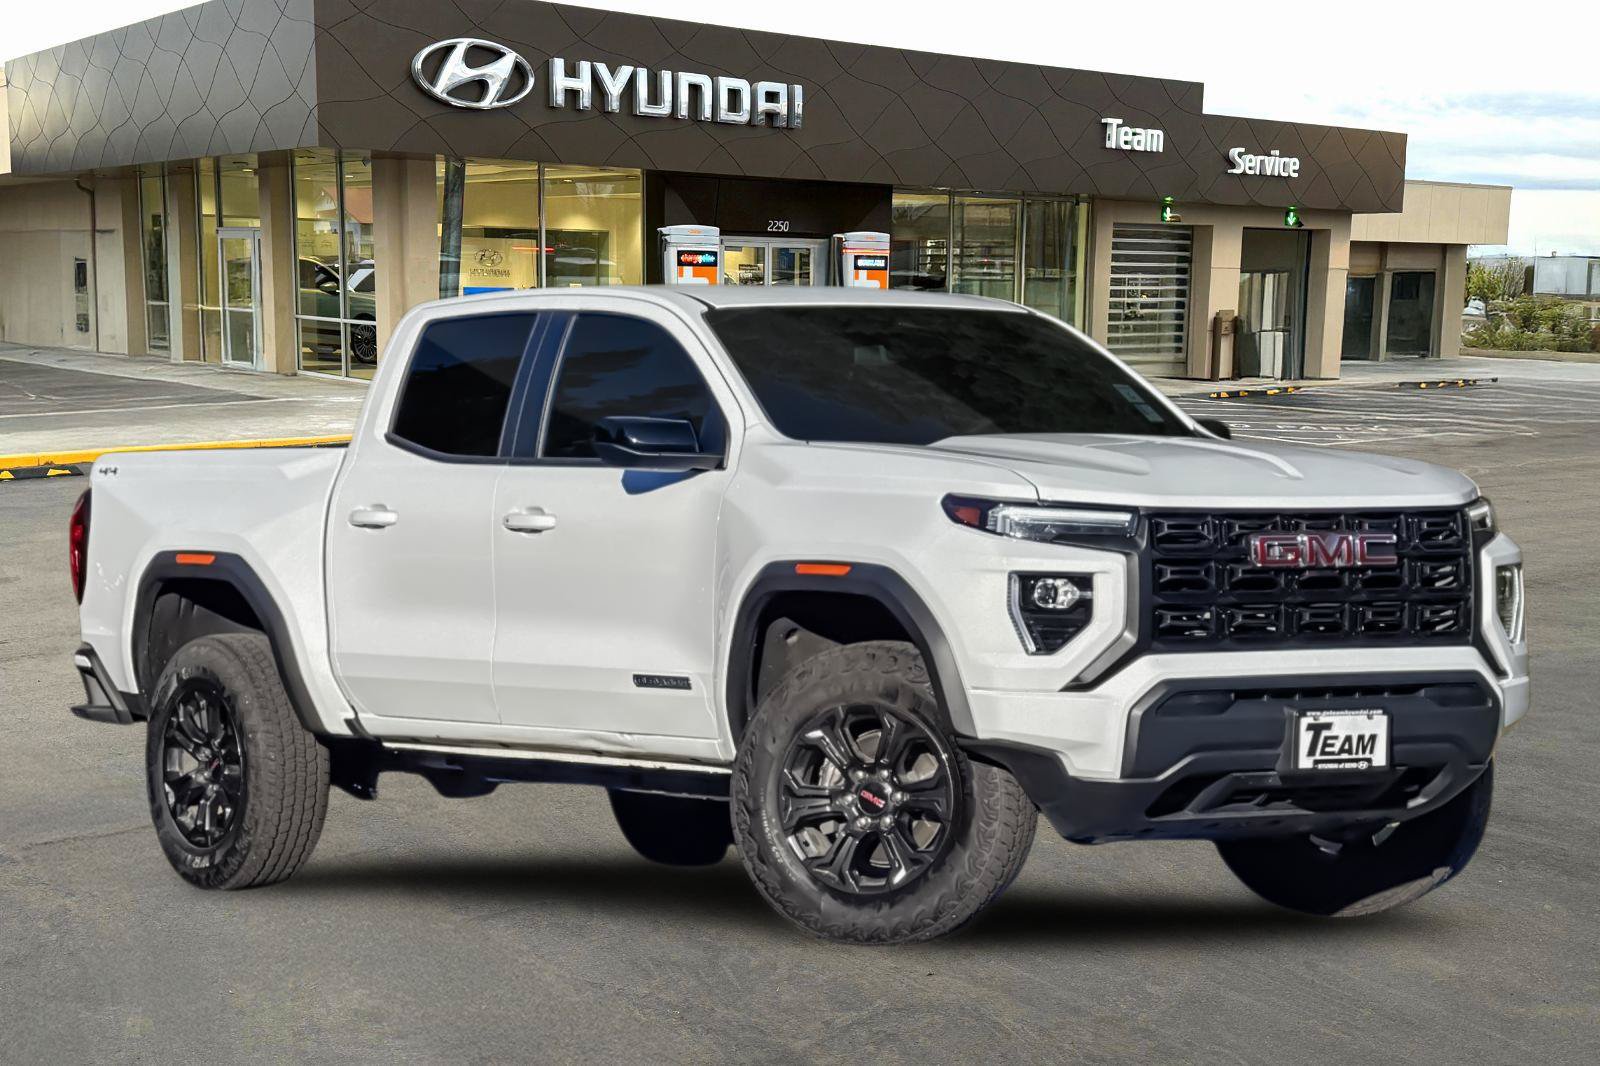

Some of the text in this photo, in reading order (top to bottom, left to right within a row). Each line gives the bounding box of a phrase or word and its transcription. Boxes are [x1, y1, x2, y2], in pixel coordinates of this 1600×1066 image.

[549, 57, 803, 129] HYUNDAI
[1101, 117, 1164, 153] Team
[1228, 147, 1300, 178] Service
[767, 220, 790, 232] 2250
[1251, 533, 1398, 568] GMC
